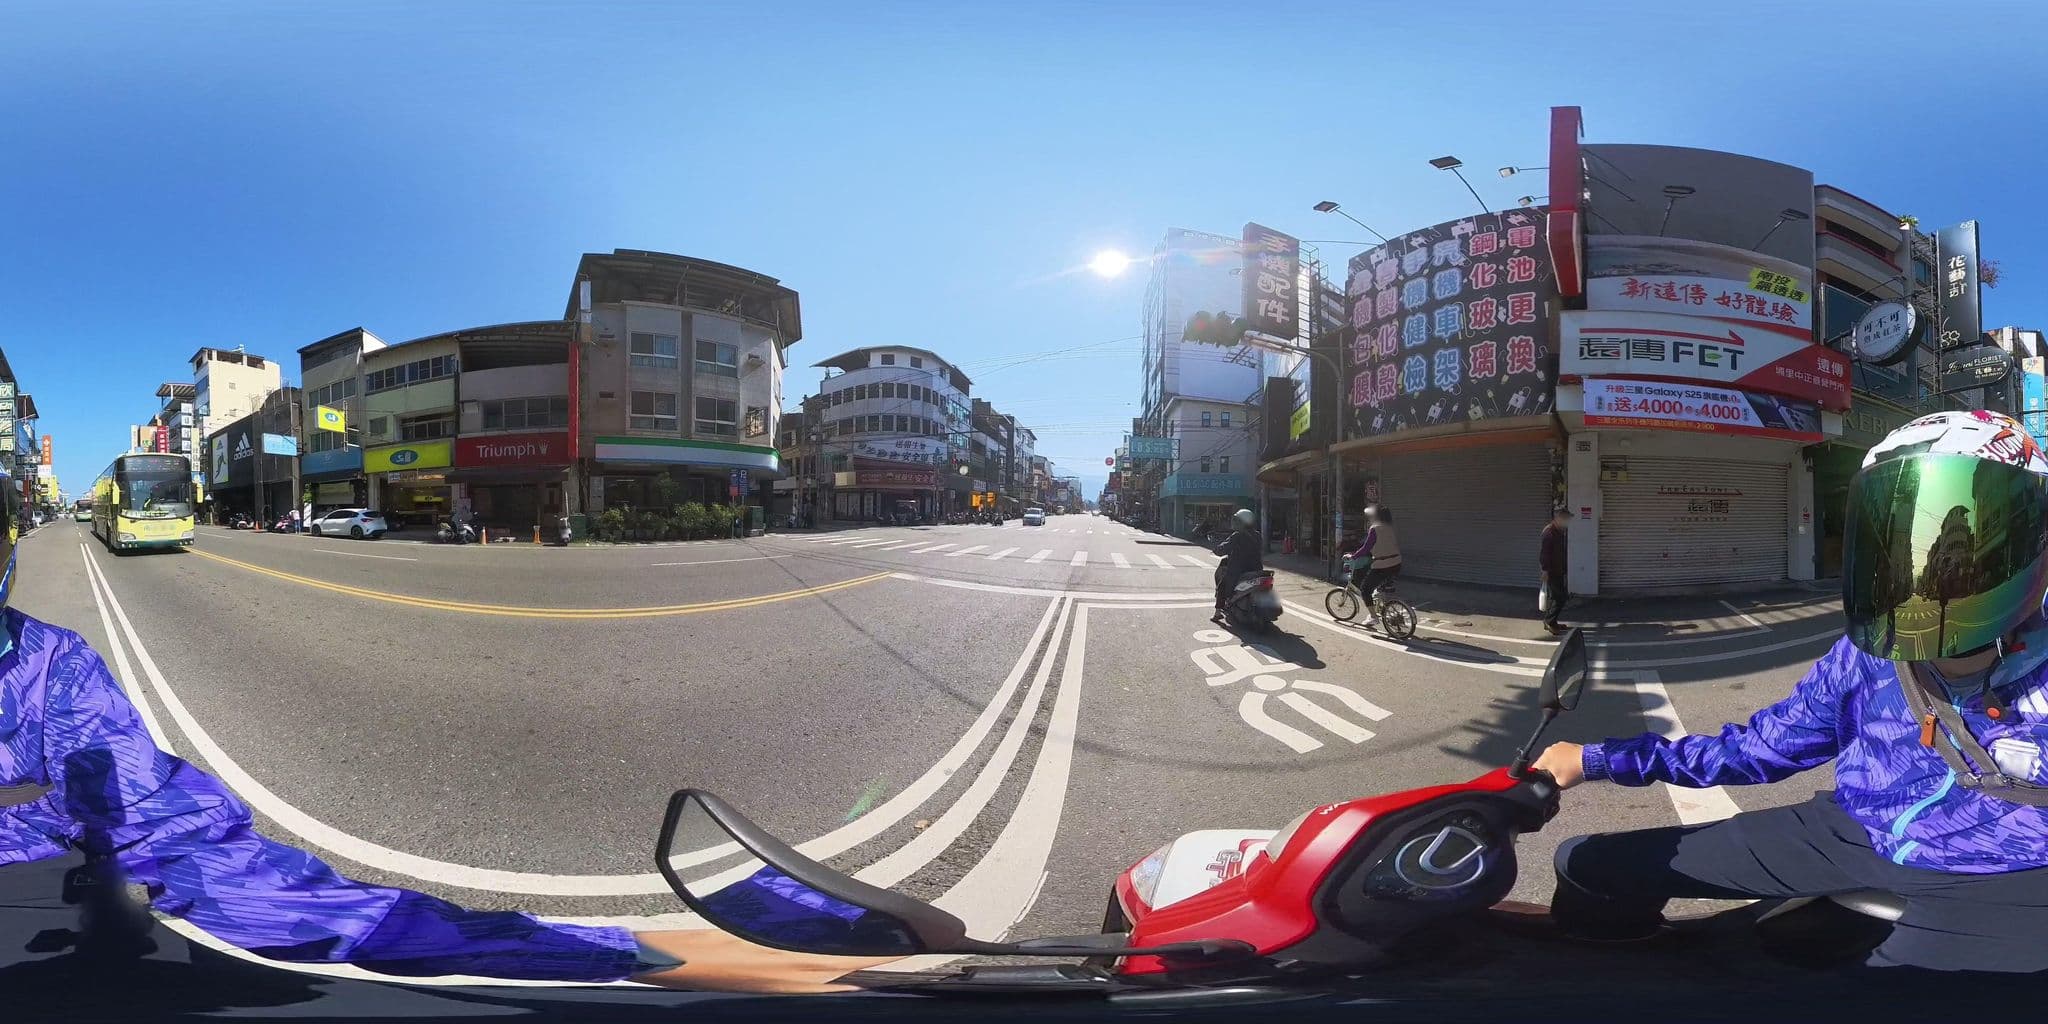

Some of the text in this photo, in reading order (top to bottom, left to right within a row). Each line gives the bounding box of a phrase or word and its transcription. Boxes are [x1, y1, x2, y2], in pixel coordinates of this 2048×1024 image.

[1256, 234, 1291, 324] 手機配件
[1432, 240, 1462, 389] 汽機車架
[1469, 232, 1497, 378] 鋼化玻璃
[1507, 226, 1536, 375] 電池更換
[1619, 278, 1799, 324] 新遠傳 好體驗
[1403, 248, 1428, 392] 手機健檢
[1864, 310, 1900, 332] 可不可
[1579, 337, 1744, 370] 遠傳 FET
[1817, 357, 1844, 377] 遠傳
[1974, 355, 2002, 363] FLORIST
[1645, 386, 1683, 398] Galaxy
[1685, 390, 1702, 398] S25
[233, 448, 254, 461] adidas
[476, 444, 535, 459] Triumph
